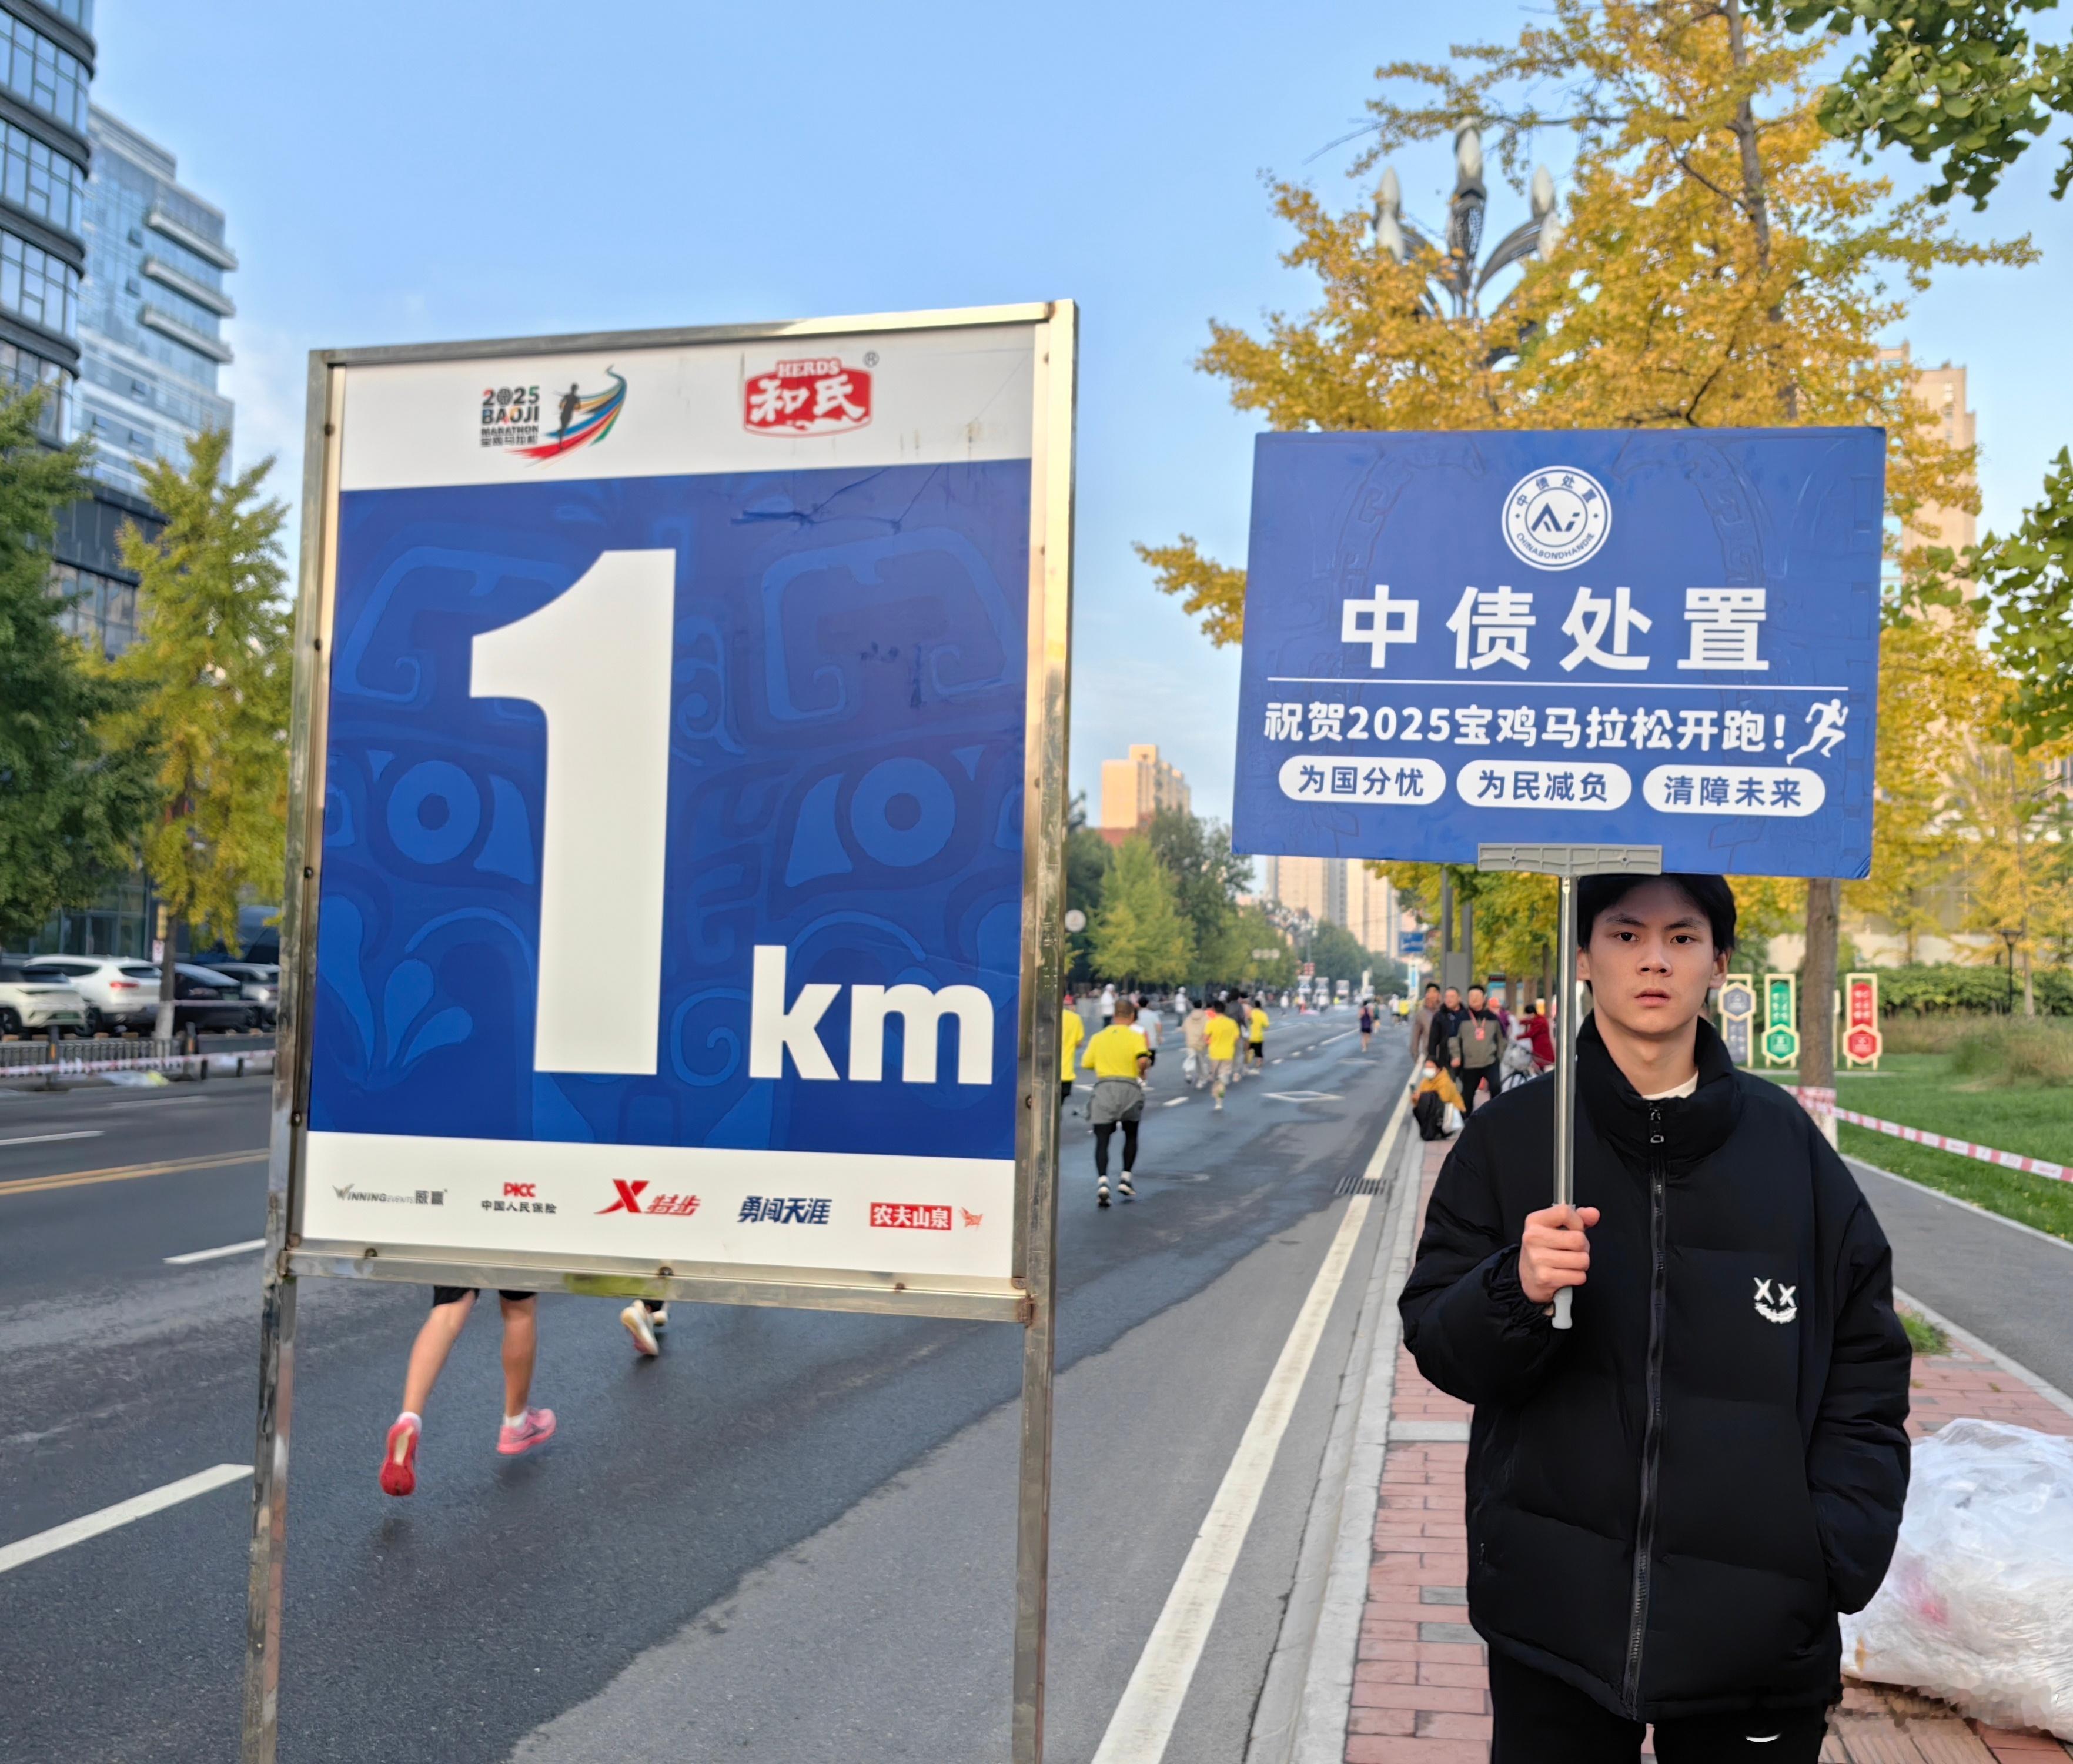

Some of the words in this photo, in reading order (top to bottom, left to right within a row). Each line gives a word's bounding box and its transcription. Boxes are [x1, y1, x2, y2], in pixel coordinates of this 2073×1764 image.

[778, 360, 840, 377] HERDS
[482, 386, 540, 406] 2025
[749, 373, 866, 423] 和氏
[482, 406, 539, 425] BAOJI
[481, 425, 539, 436] MARATHON
[1341, 584, 1769, 671] 中债处置
[1298, 764, 1425, 797] 为国分忧
[1477, 770, 1608, 803] 为民减负
[1664, 775, 1801, 808] 清障未来
[470, 548, 676, 1075] 1
[749, 945, 994, 1084] km
[503, 1182, 536, 1197] PICC
[481, 1200, 557, 1214] 中国人民保险
[737, 1195, 833, 1224] 勇闯天涯
[873, 1205, 949, 1228] 农夫山泉
